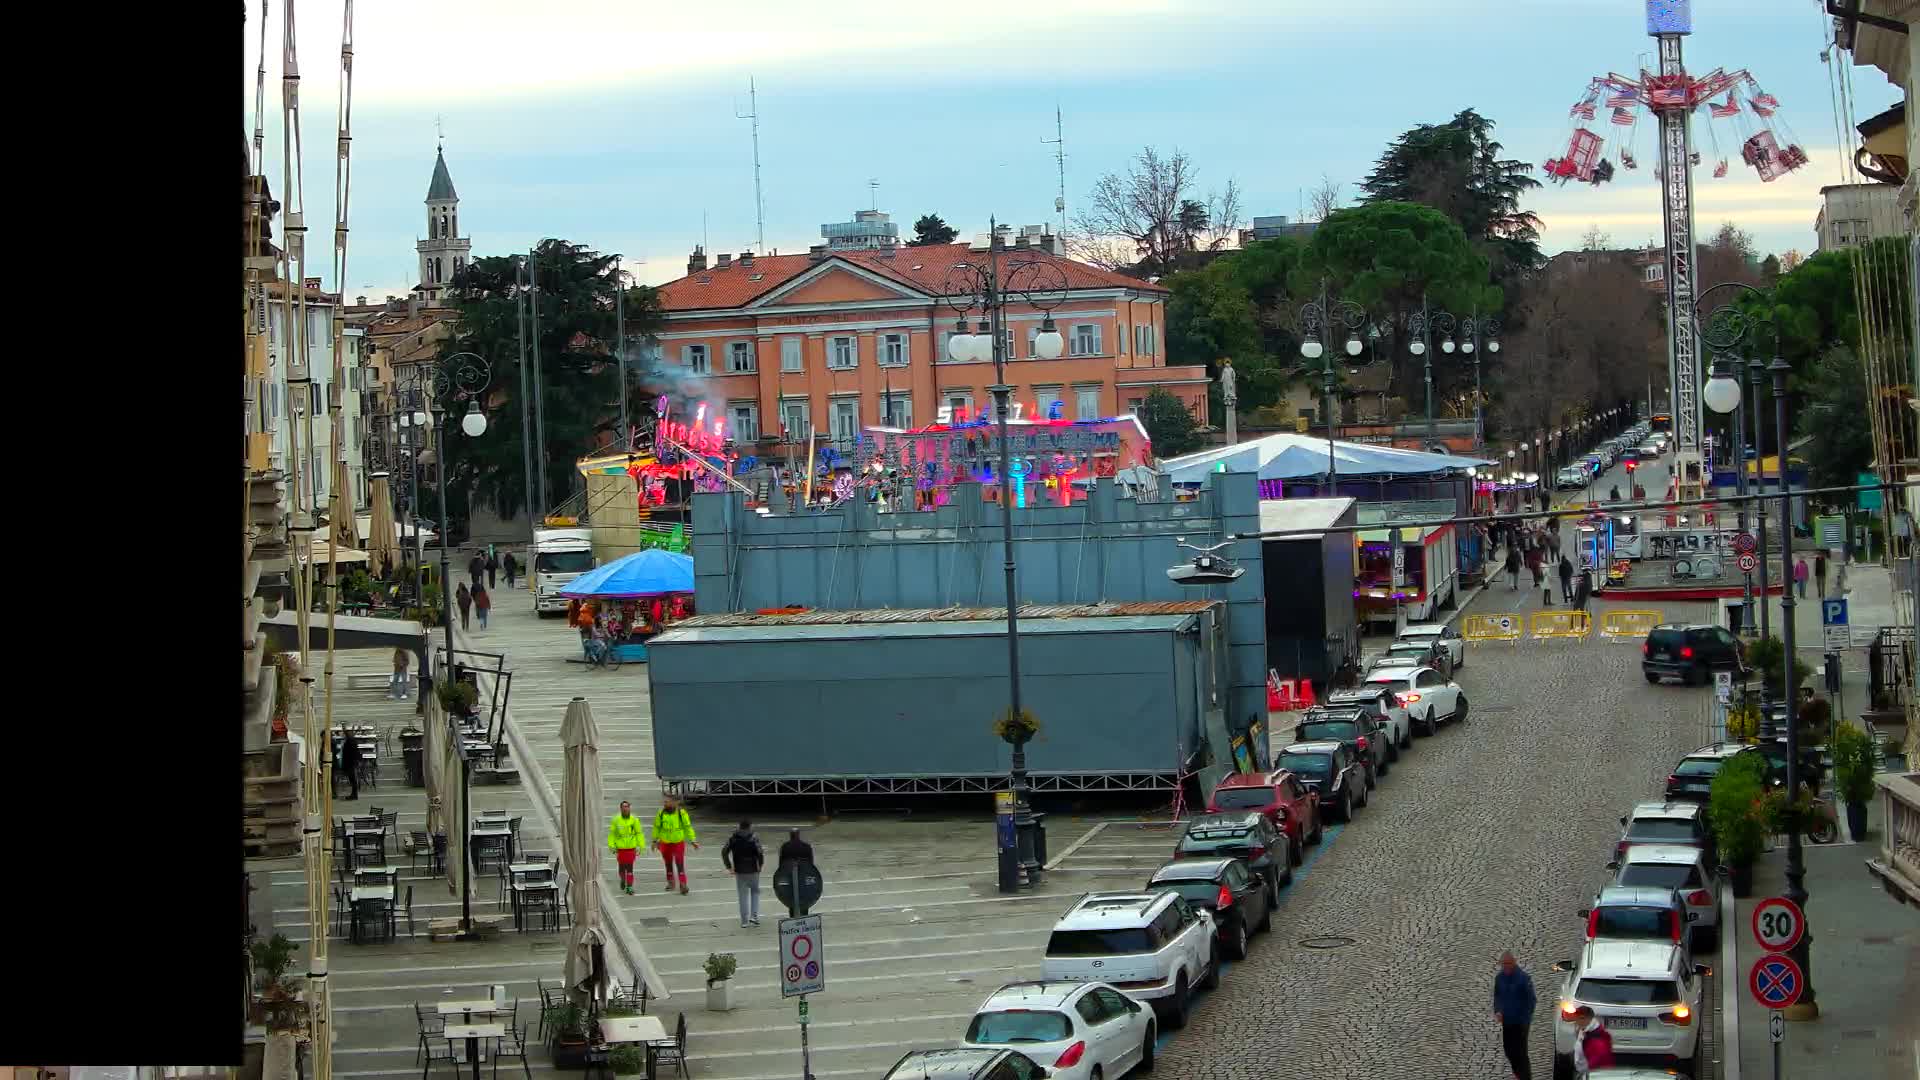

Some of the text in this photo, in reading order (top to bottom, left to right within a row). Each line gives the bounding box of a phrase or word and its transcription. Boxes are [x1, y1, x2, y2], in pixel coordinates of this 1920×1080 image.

[1742, 558, 1752, 568] 20
[1827, 602, 1842, 622] P
[1762, 911, 1792, 938] 30
